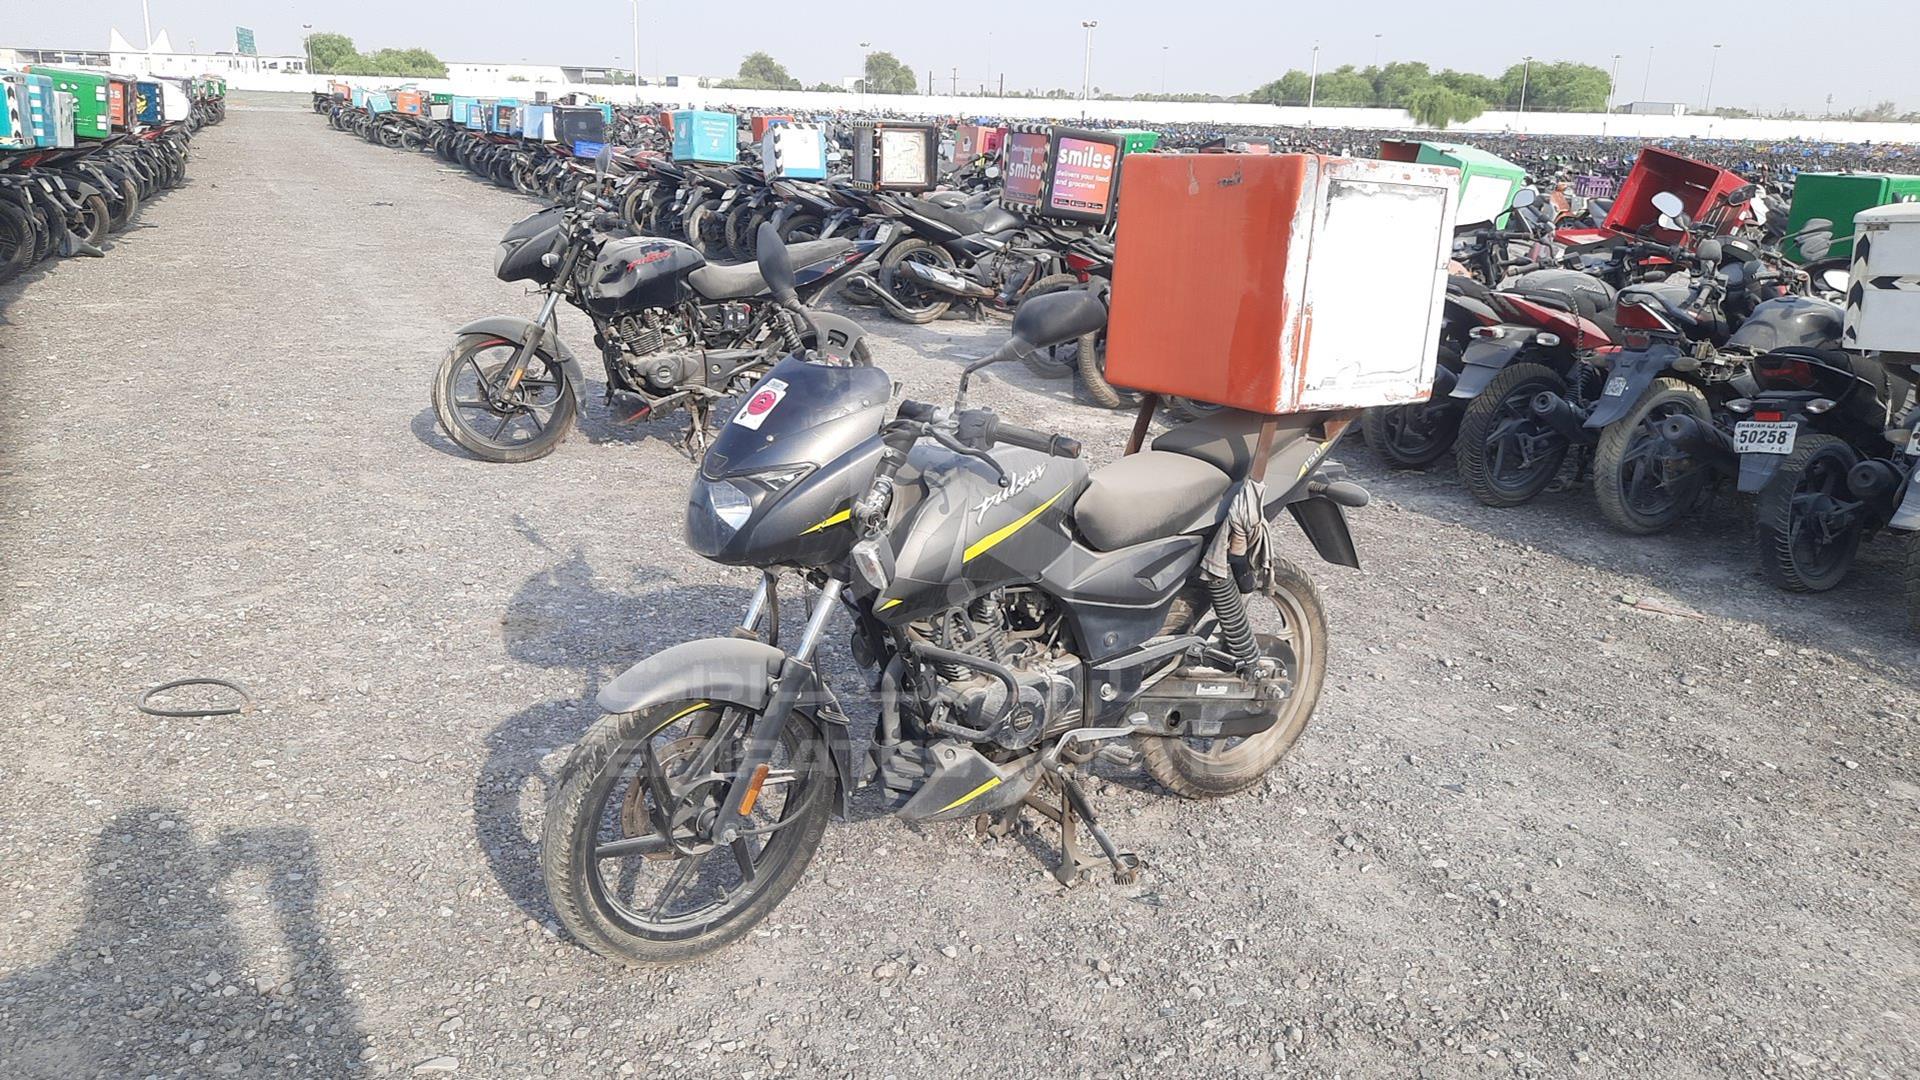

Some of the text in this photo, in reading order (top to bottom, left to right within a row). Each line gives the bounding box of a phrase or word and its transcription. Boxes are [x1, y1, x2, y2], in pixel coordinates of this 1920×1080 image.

[1059, 146, 1112, 170] smiles
[1009, 161, 1042, 180] smiles
[1056, 170, 1109, 183] delivers your food
[1056, 178, 1096, 189] and groceries
[1739, 430, 1787, 445] 50258
